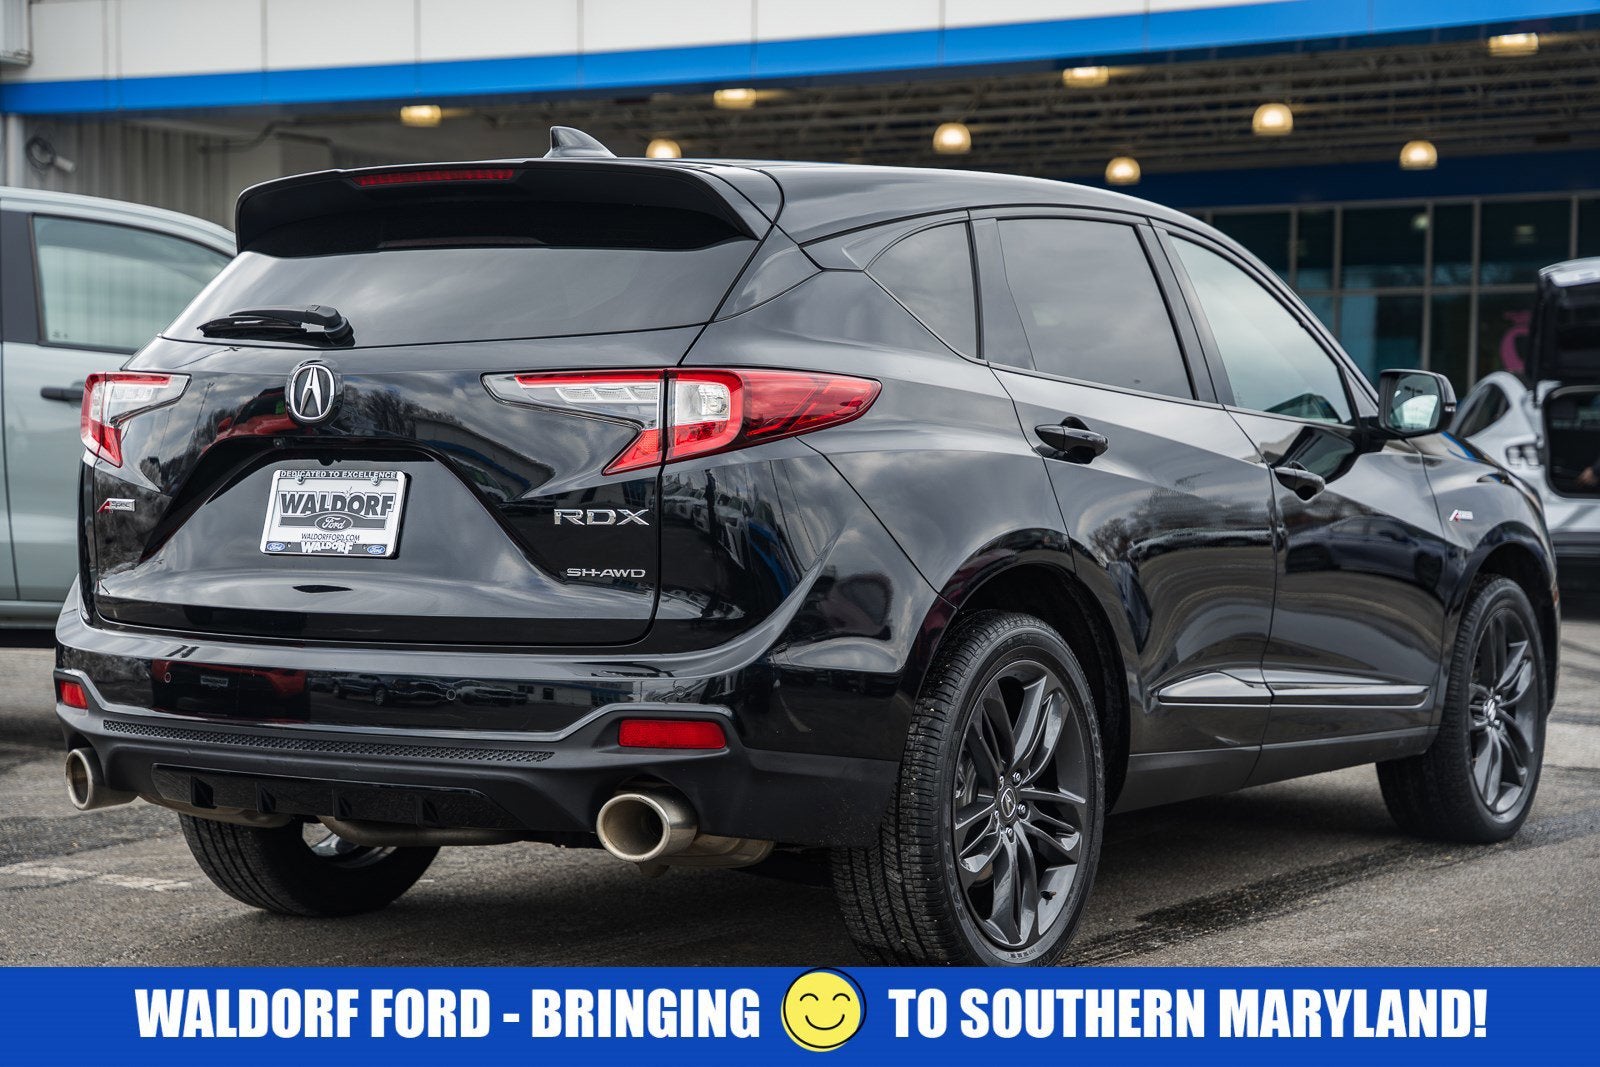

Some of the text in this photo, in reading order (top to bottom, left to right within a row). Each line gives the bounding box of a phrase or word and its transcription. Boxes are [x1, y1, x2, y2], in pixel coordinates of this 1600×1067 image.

[342, 471, 396, 479] EXCELLENCE
[279, 491, 396, 517] WALDORF
[321, 516, 347, 530] Ford
[553, 508, 650, 526] RDX
[301, 533, 360, 542] WALDORFFORD.COM
[300, 541, 354, 554] WALDORF
[566, 567, 646, 578] SH-AWD
